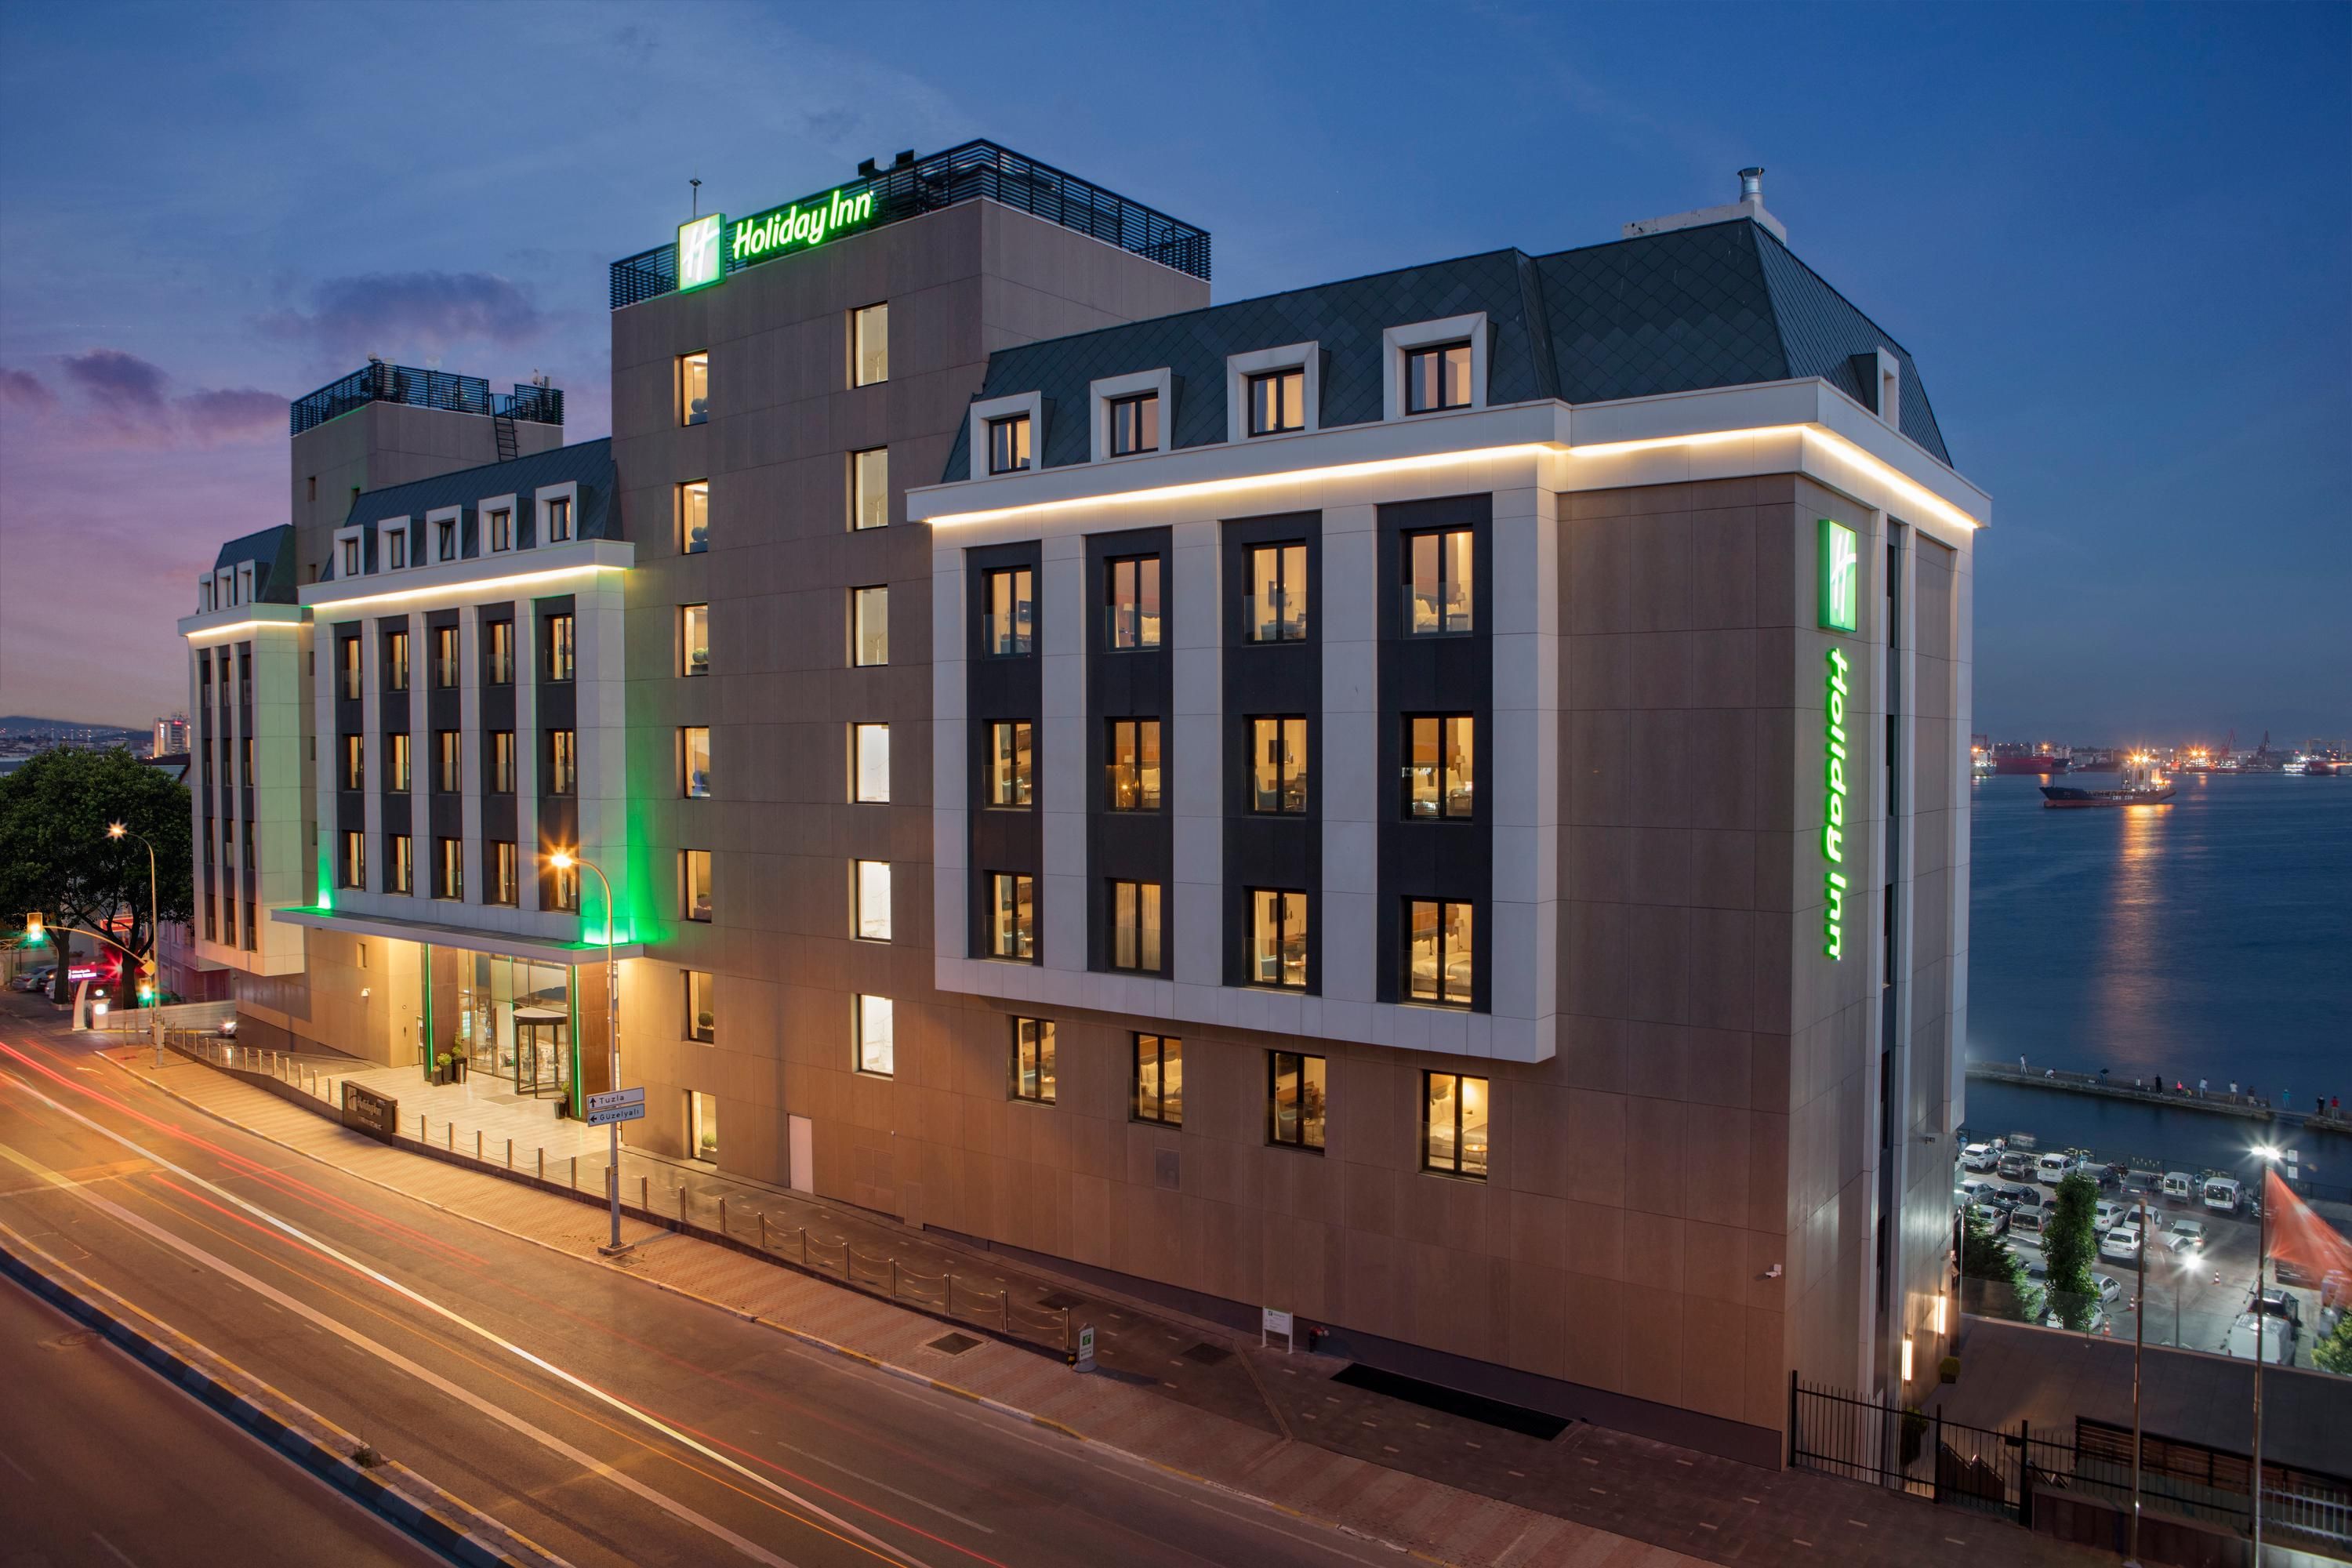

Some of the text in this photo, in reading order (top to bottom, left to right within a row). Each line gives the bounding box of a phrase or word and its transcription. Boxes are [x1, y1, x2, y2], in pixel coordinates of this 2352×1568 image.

[733, 190, 872, 260] Holiday Inn
[1826, 648, 1848, 957] Holiday Inn
[599, 1094, 625, 1105] Tuzla
